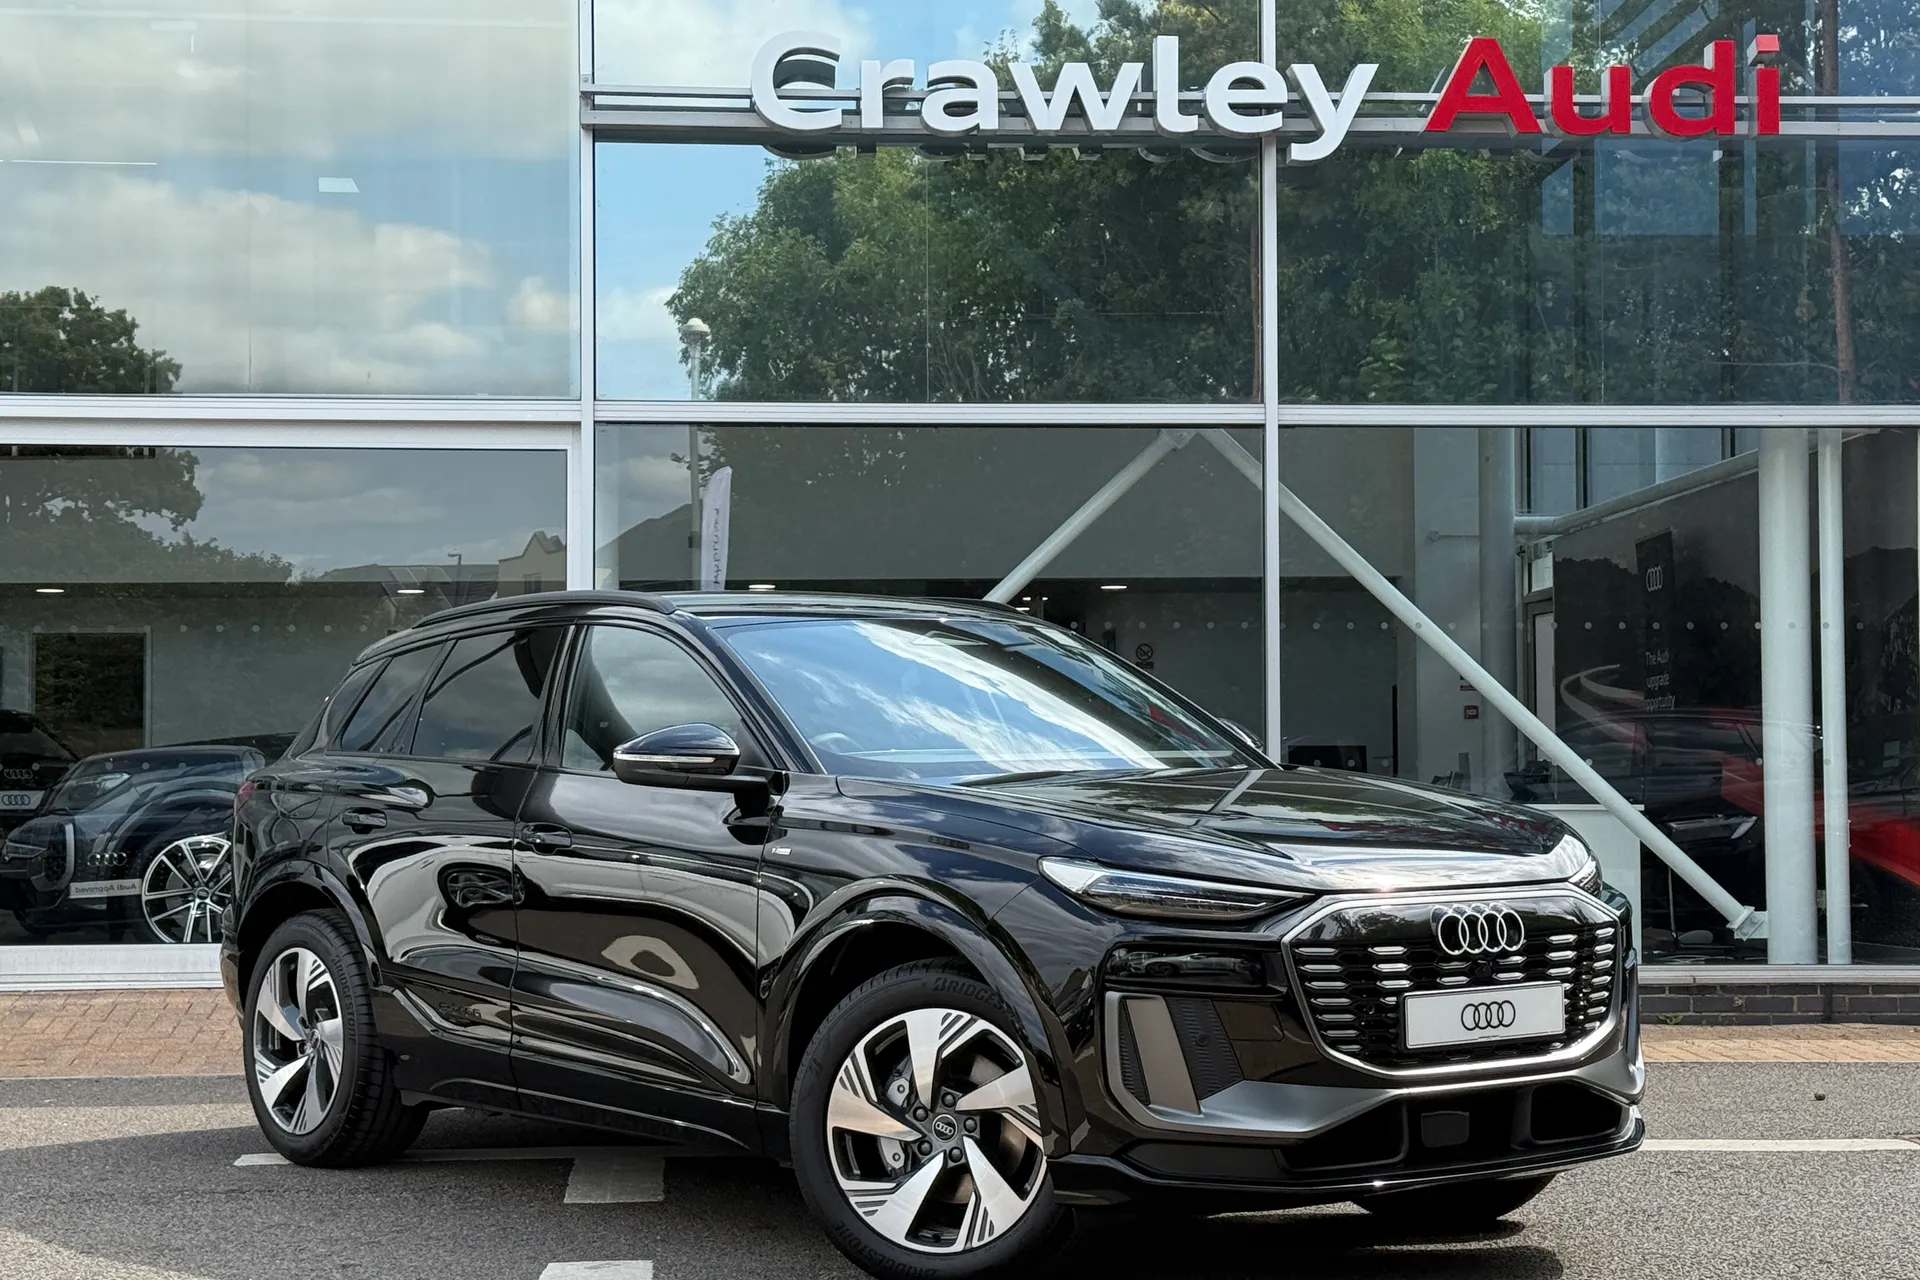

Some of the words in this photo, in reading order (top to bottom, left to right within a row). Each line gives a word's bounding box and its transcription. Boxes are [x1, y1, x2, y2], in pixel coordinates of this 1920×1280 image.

[751, 30, 1380, 166] Crawley
[1422, 34, 1780, 137] Audi
[332, 954, 357, 1045] BRIDGESTONE
[932, 976, 1006, 1010] BRIDGES
